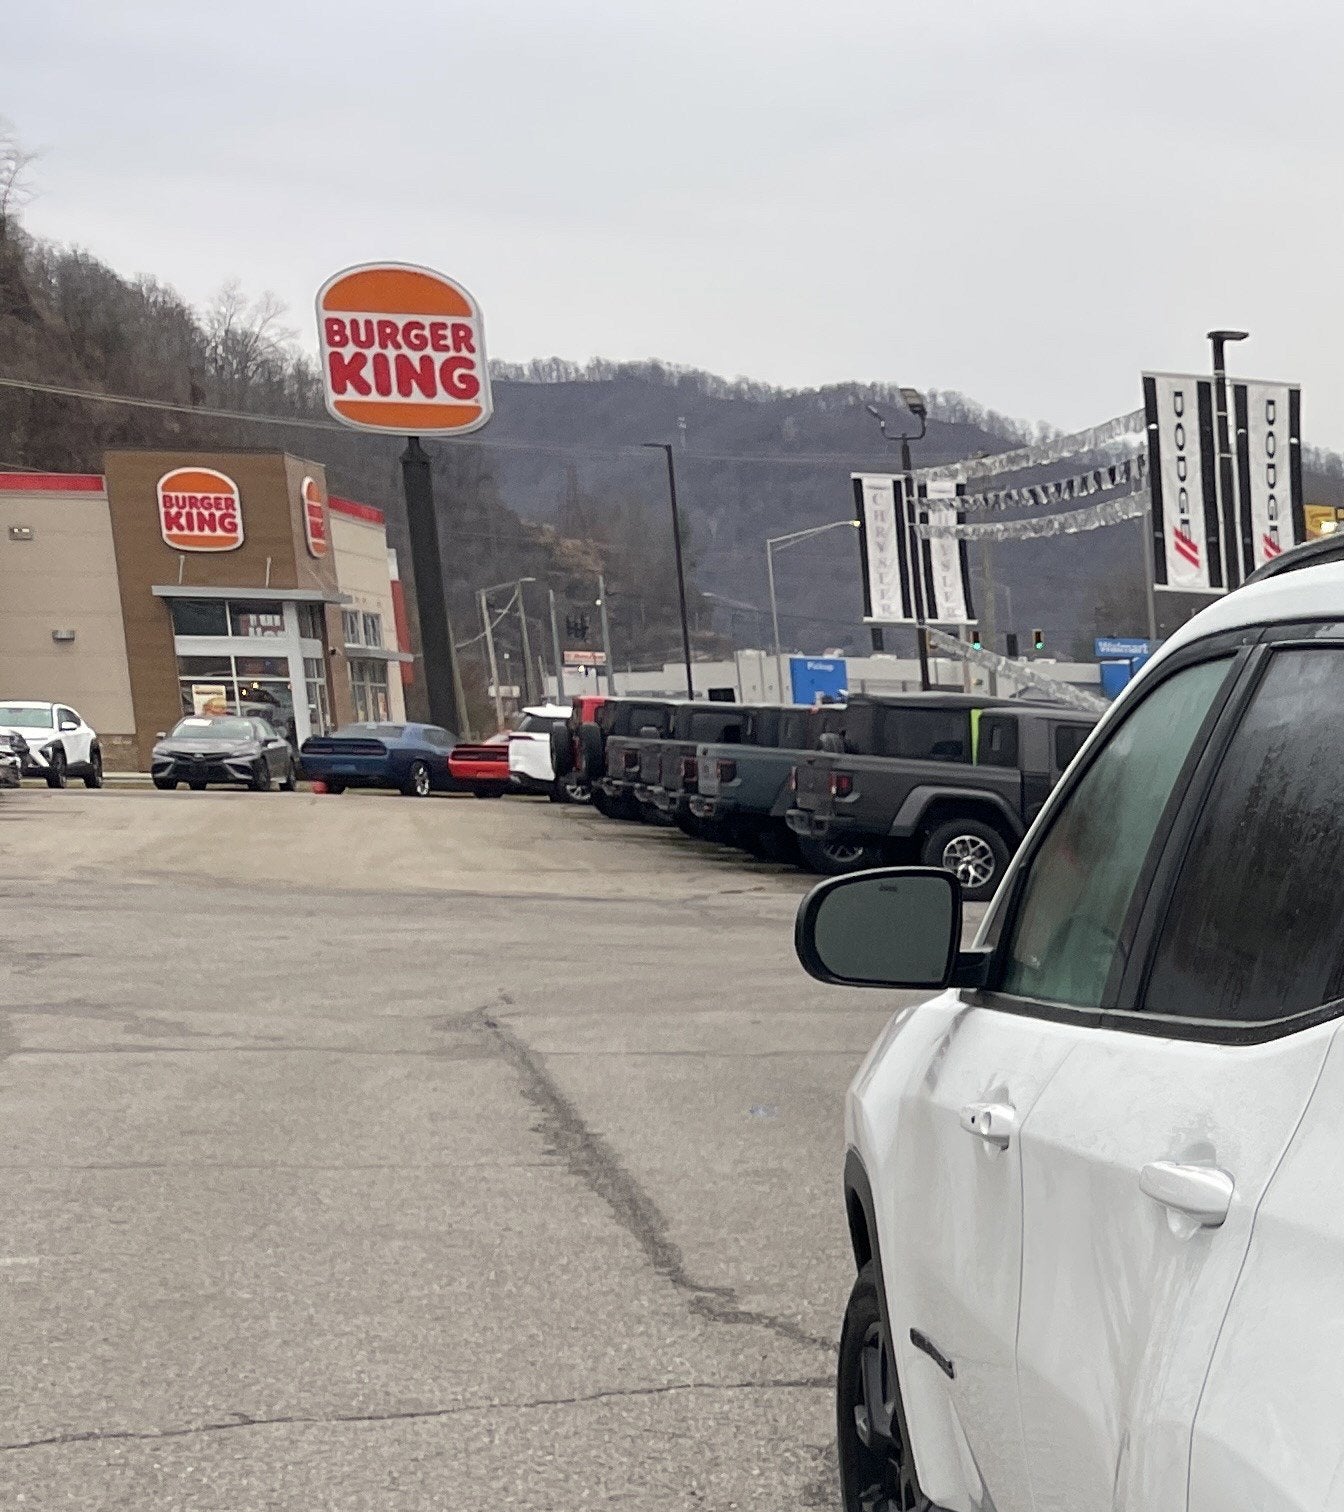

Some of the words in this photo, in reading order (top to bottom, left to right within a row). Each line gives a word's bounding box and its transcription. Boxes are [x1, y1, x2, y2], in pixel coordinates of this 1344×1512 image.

[325, 317, 476, 354] BURGER
[328, 351, 480, 400] KING
[1174, 391, 1191, 542] DODGE
[1266, 400, 1281, 549] DODGE
[163, 494, 236, 511] BURGER
[164, 510, 238, 533] KING
